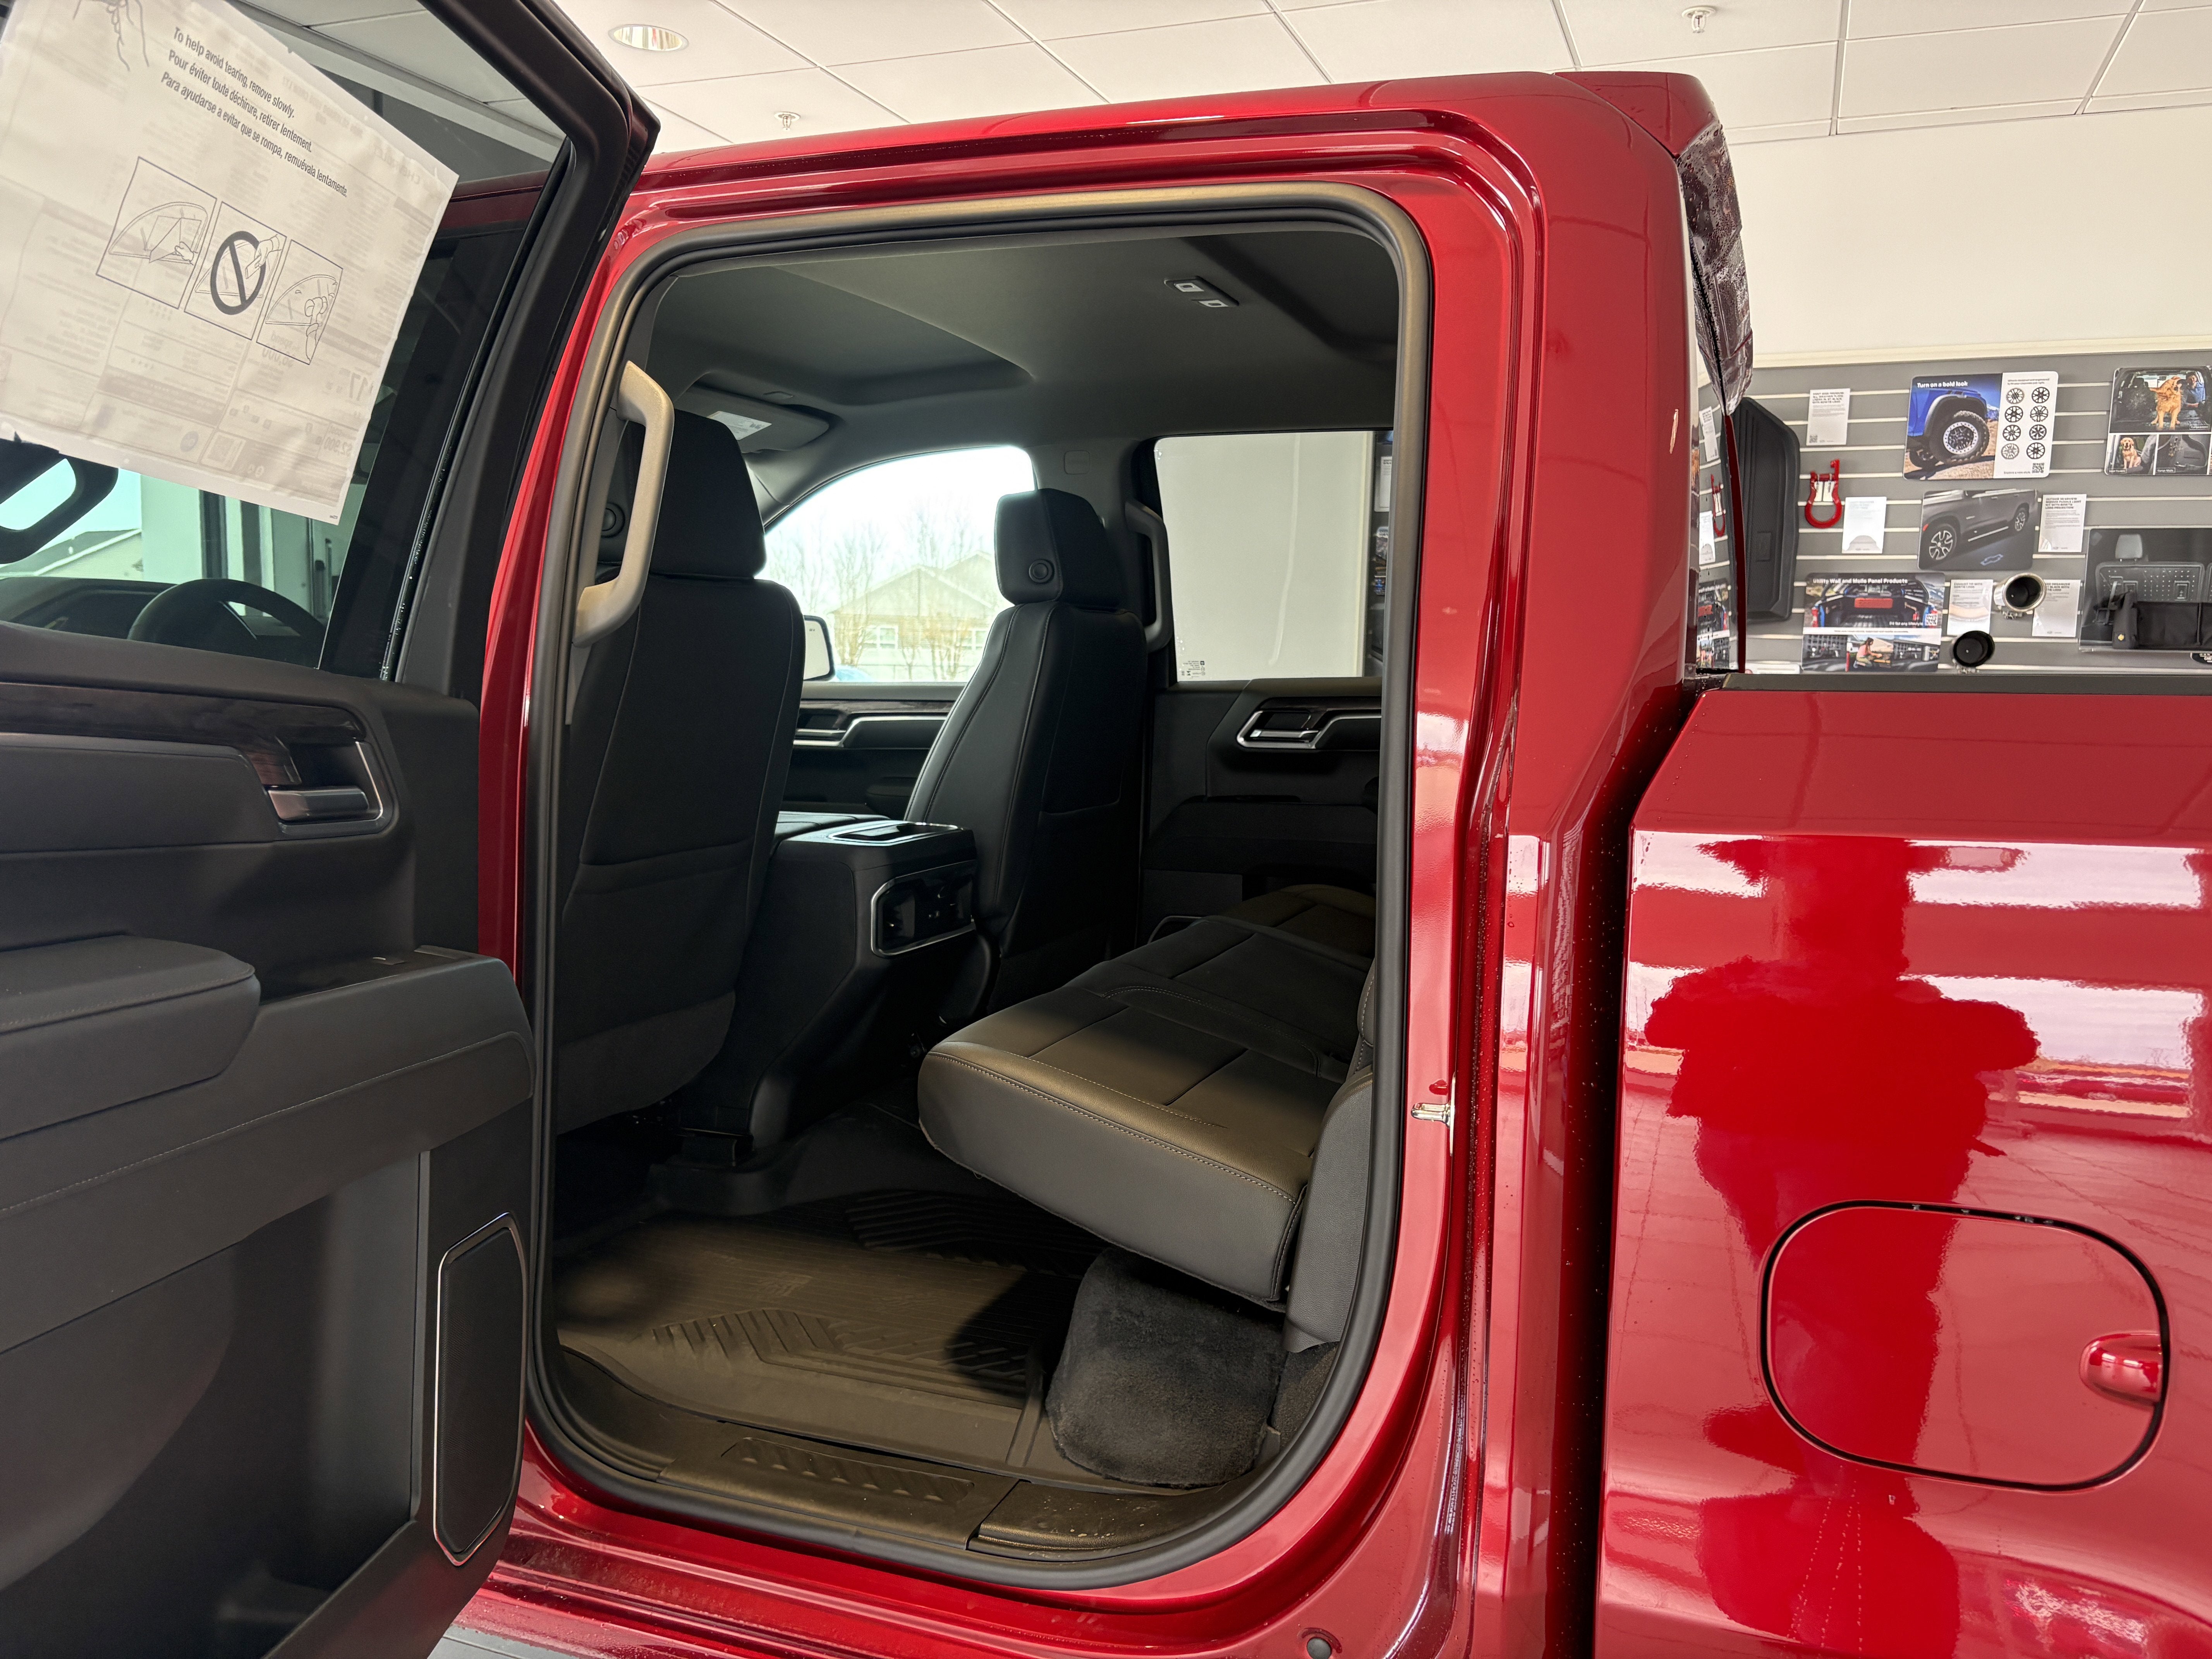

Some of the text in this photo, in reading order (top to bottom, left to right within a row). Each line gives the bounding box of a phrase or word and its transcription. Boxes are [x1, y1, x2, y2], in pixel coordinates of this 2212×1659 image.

[169, 49, 312, 153] Pour éviter toute déchirure, retirer lentement.
[174, 27, 294, 118] To help avoid tearing, remove slowly.
[161, 71, 347, 198] Para ayudarse a evitar que se rompa, remuévala lentamente.
